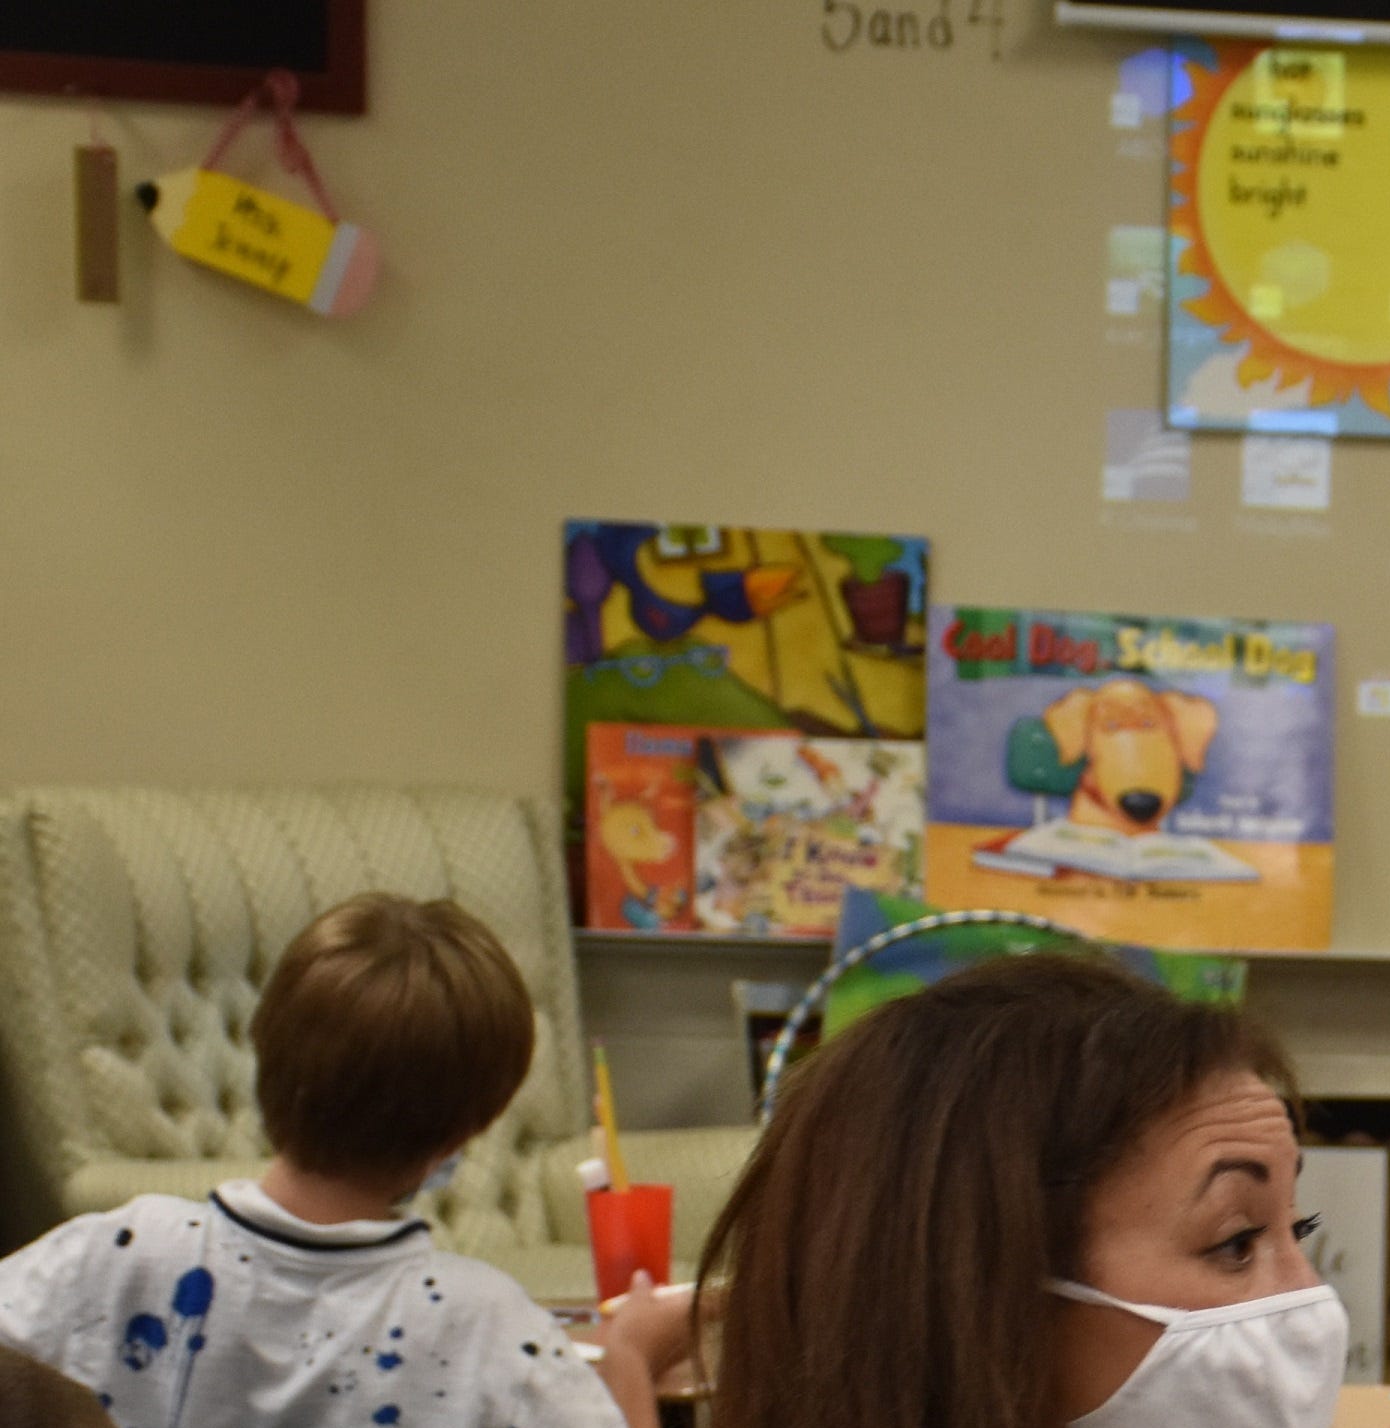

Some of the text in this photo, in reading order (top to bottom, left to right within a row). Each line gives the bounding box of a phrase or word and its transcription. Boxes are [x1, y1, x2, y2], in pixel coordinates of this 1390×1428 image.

[1230, 139, 1341, 168] sunshine
[1228, 176, 1307, 221] bright
[943, 617, 1017, 663] Cool
[1115, 627, 1235, 672] School
[1244, 632, 1318, 684] Dog
